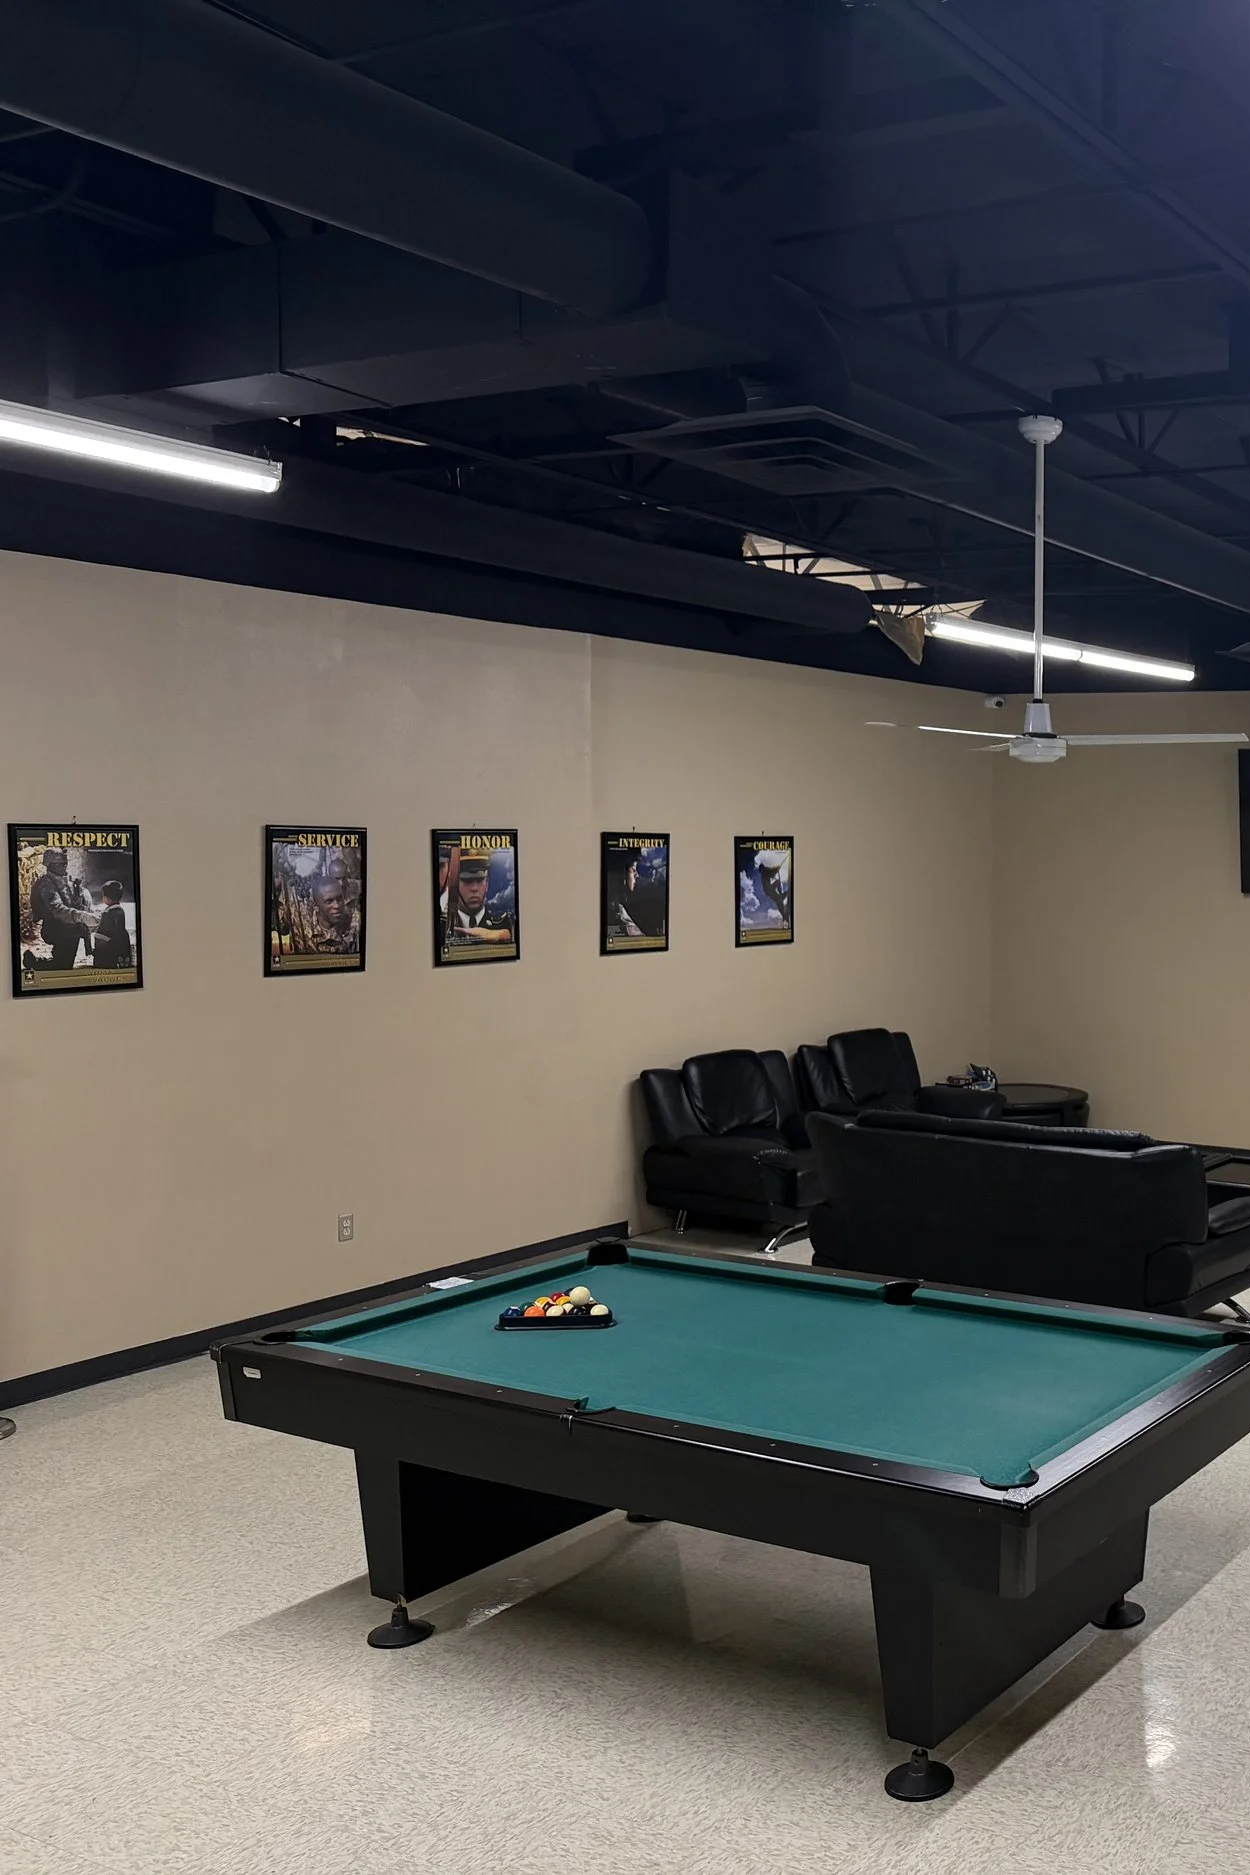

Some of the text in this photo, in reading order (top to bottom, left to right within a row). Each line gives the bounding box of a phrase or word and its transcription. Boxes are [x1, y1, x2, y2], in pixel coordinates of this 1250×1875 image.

[47, 832, 130, 847] RESPECT
[298, 833, 359, 847] SERVICE
[460, 835, 511, 849] HONOR
[619, 838, 665, 848] INTEGRITY
[753, 841, 790, 850] COURAGE
